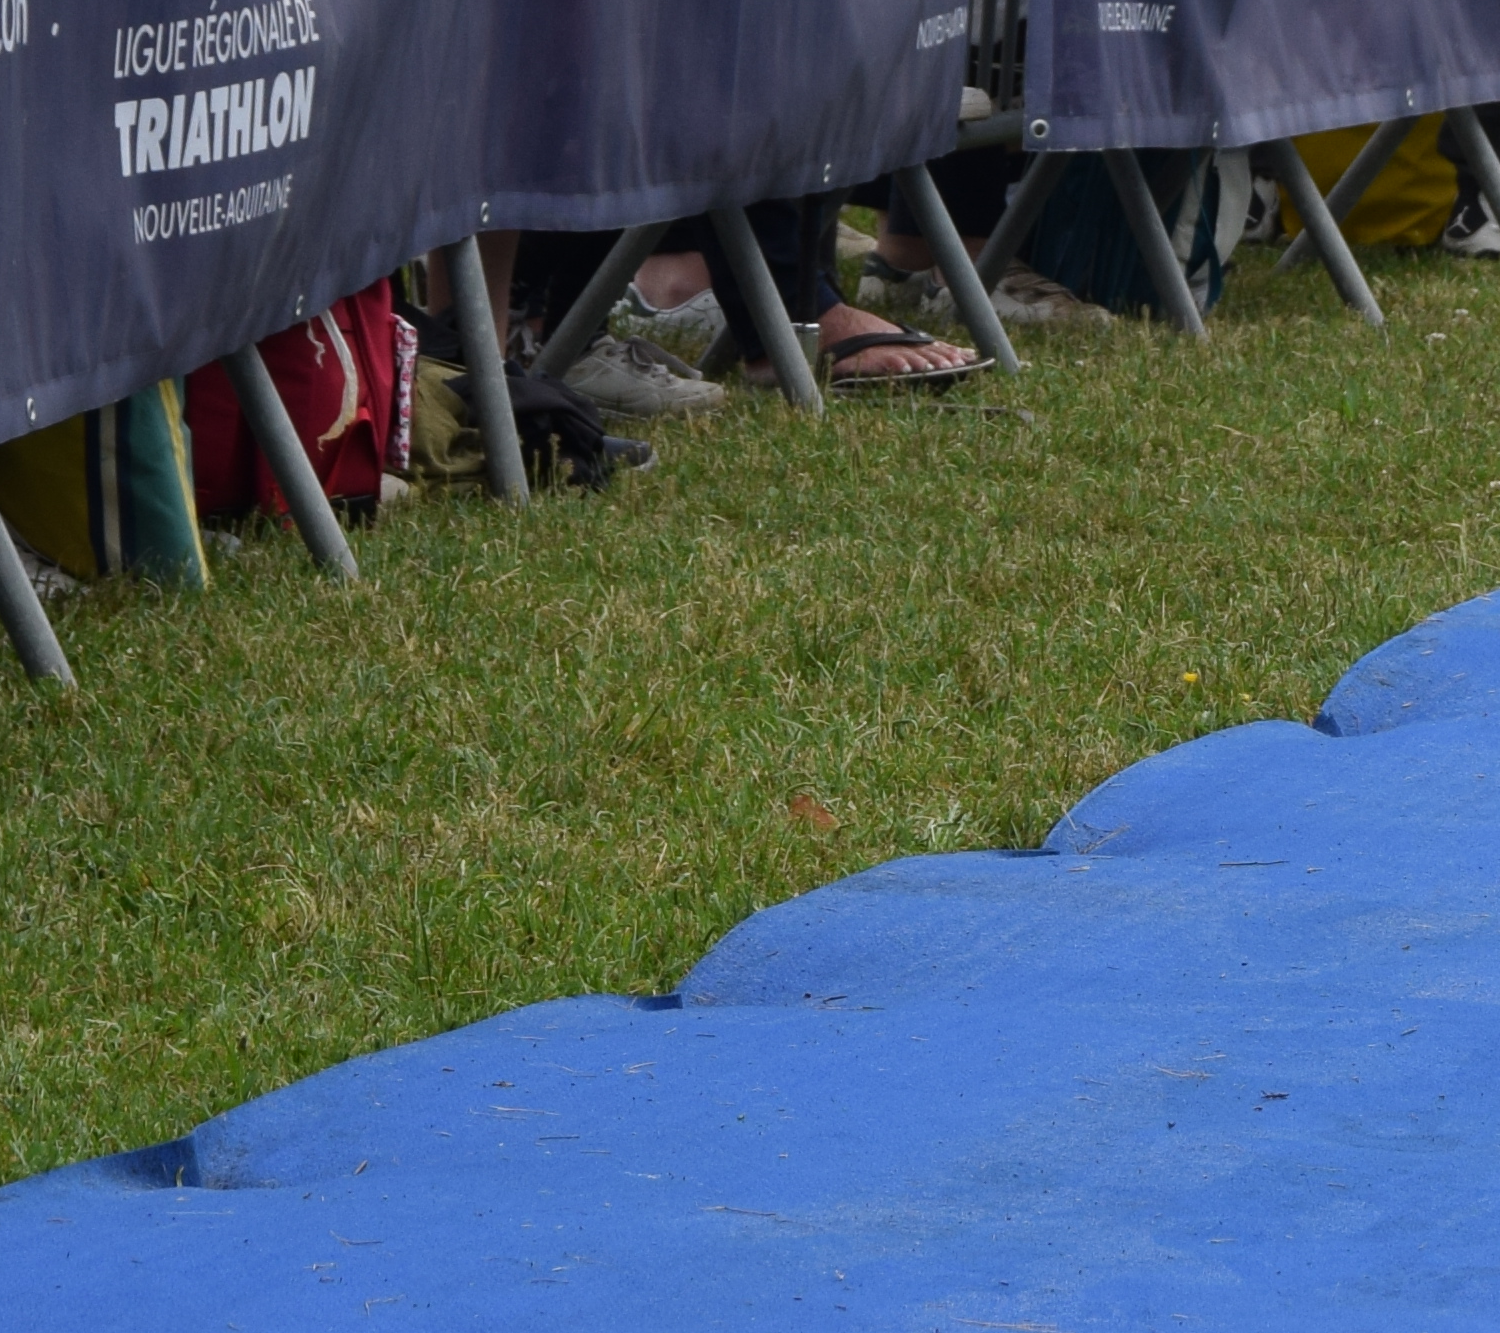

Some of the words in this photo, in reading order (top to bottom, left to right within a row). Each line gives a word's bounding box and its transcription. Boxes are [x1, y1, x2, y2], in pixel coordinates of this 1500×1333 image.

[114, 18, 188, 79] LIGUE
[114, 65, 316, 178] TRIATHLON
[133, 173, 293, 245] NOUVELLE-AQUITAINE
